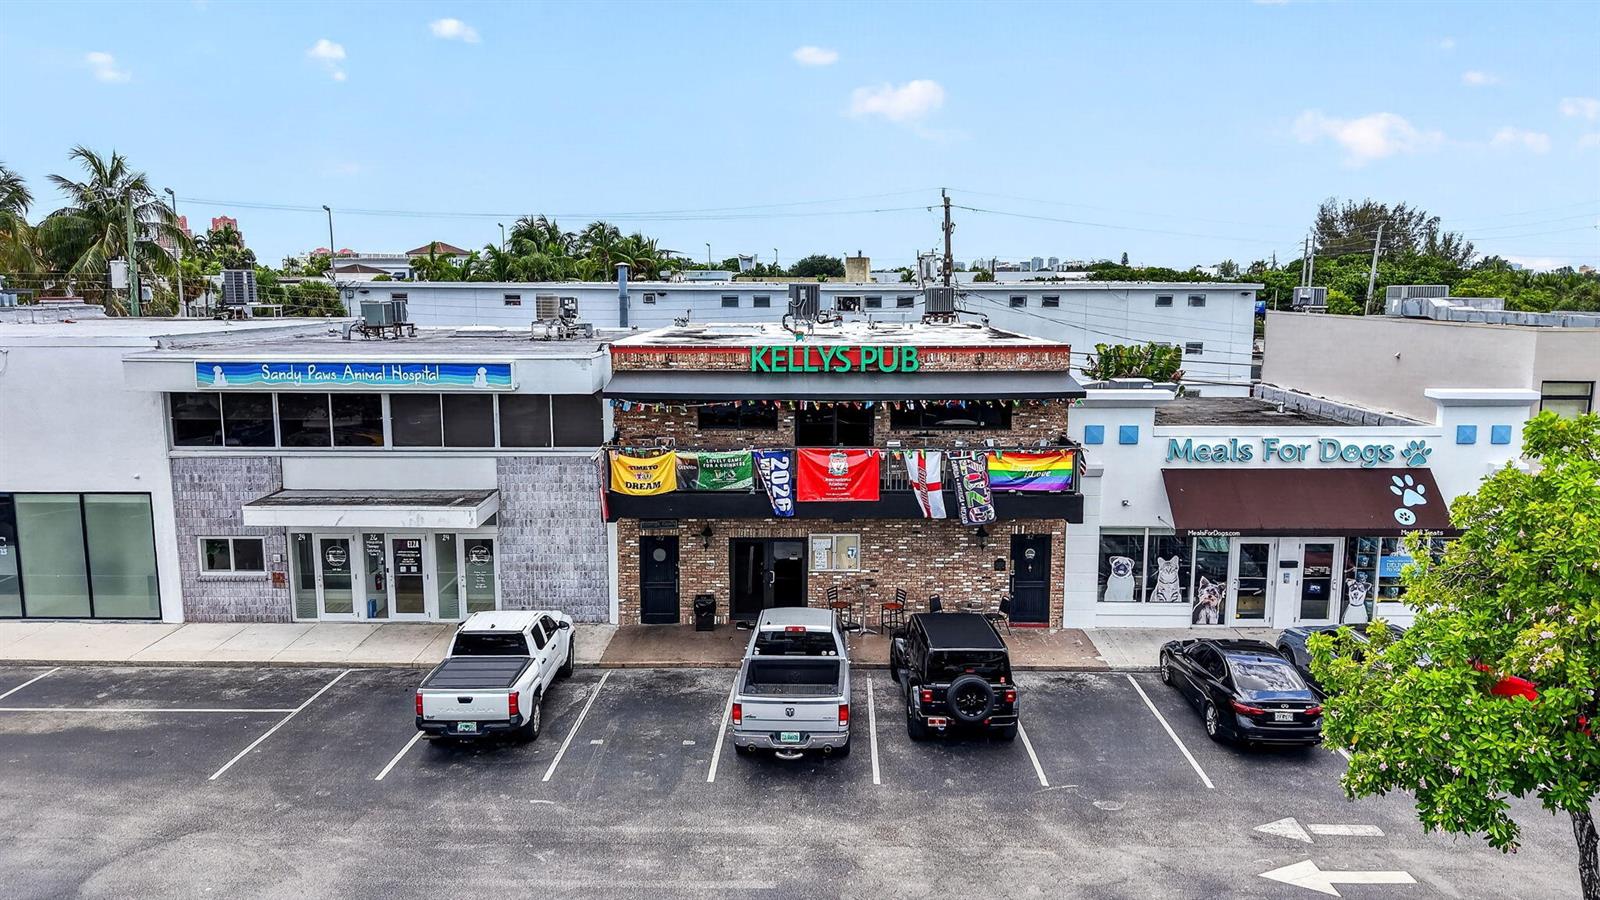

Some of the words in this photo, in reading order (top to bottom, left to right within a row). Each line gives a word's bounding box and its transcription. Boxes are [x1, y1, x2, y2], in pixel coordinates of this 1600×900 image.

[751, 346, 851, 373] KELLYS
[860, 346, 919, 373] PUB
[261, 364, 301, 387] Sandy
[308, 365, 336, 381] Paws
[342, 364, 386, 381] Animal
[391, 364, 439, 385] Hospital
[1166, 438, 1253, 463] Meals
[1262, 438, 1311, 463] For
[1318, 438, 1395, 468] Dogs
[625, 481, 661, 490] DREAM
[771, 457, 792, 512] 2026
[1031, 470, 1051, 478] Love
[1187, 529, 1240, 537] MealsForDogs.com
